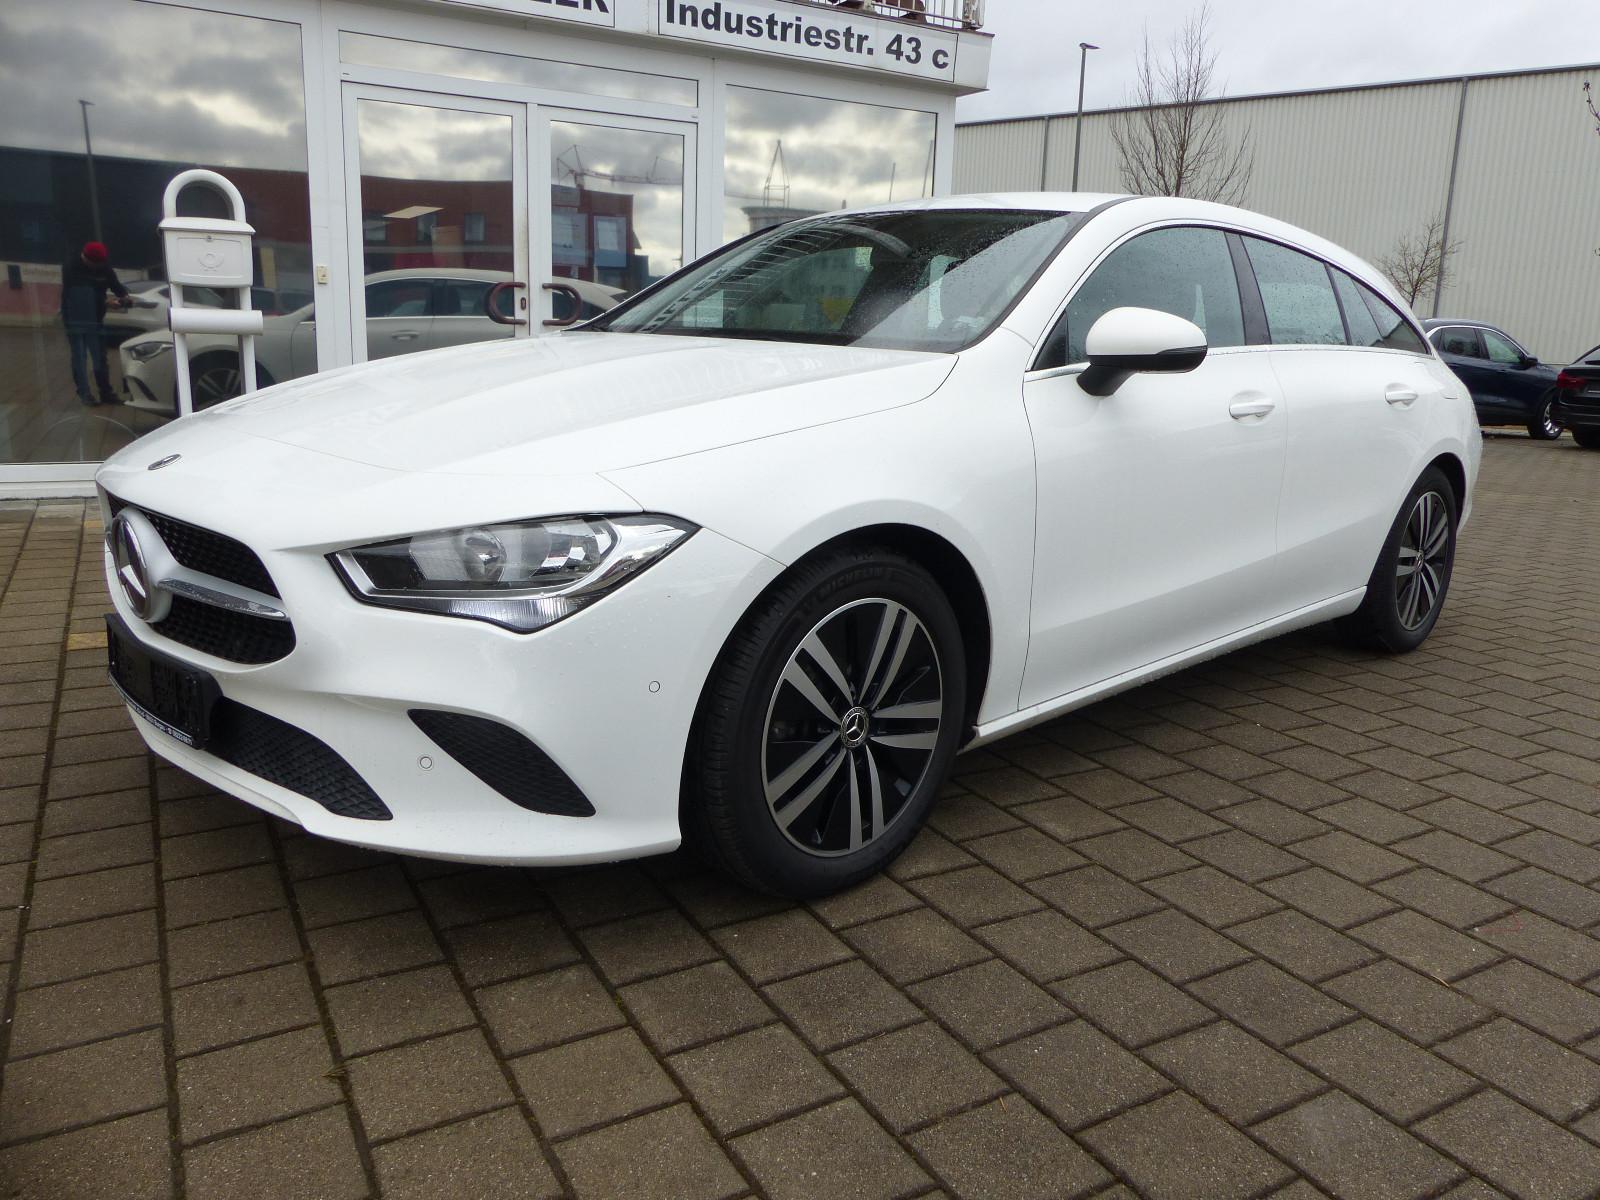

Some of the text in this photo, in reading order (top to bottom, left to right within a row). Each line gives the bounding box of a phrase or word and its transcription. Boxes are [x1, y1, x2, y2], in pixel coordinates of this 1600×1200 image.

[666, 0, 949, 69] Industriestr. 43 c
